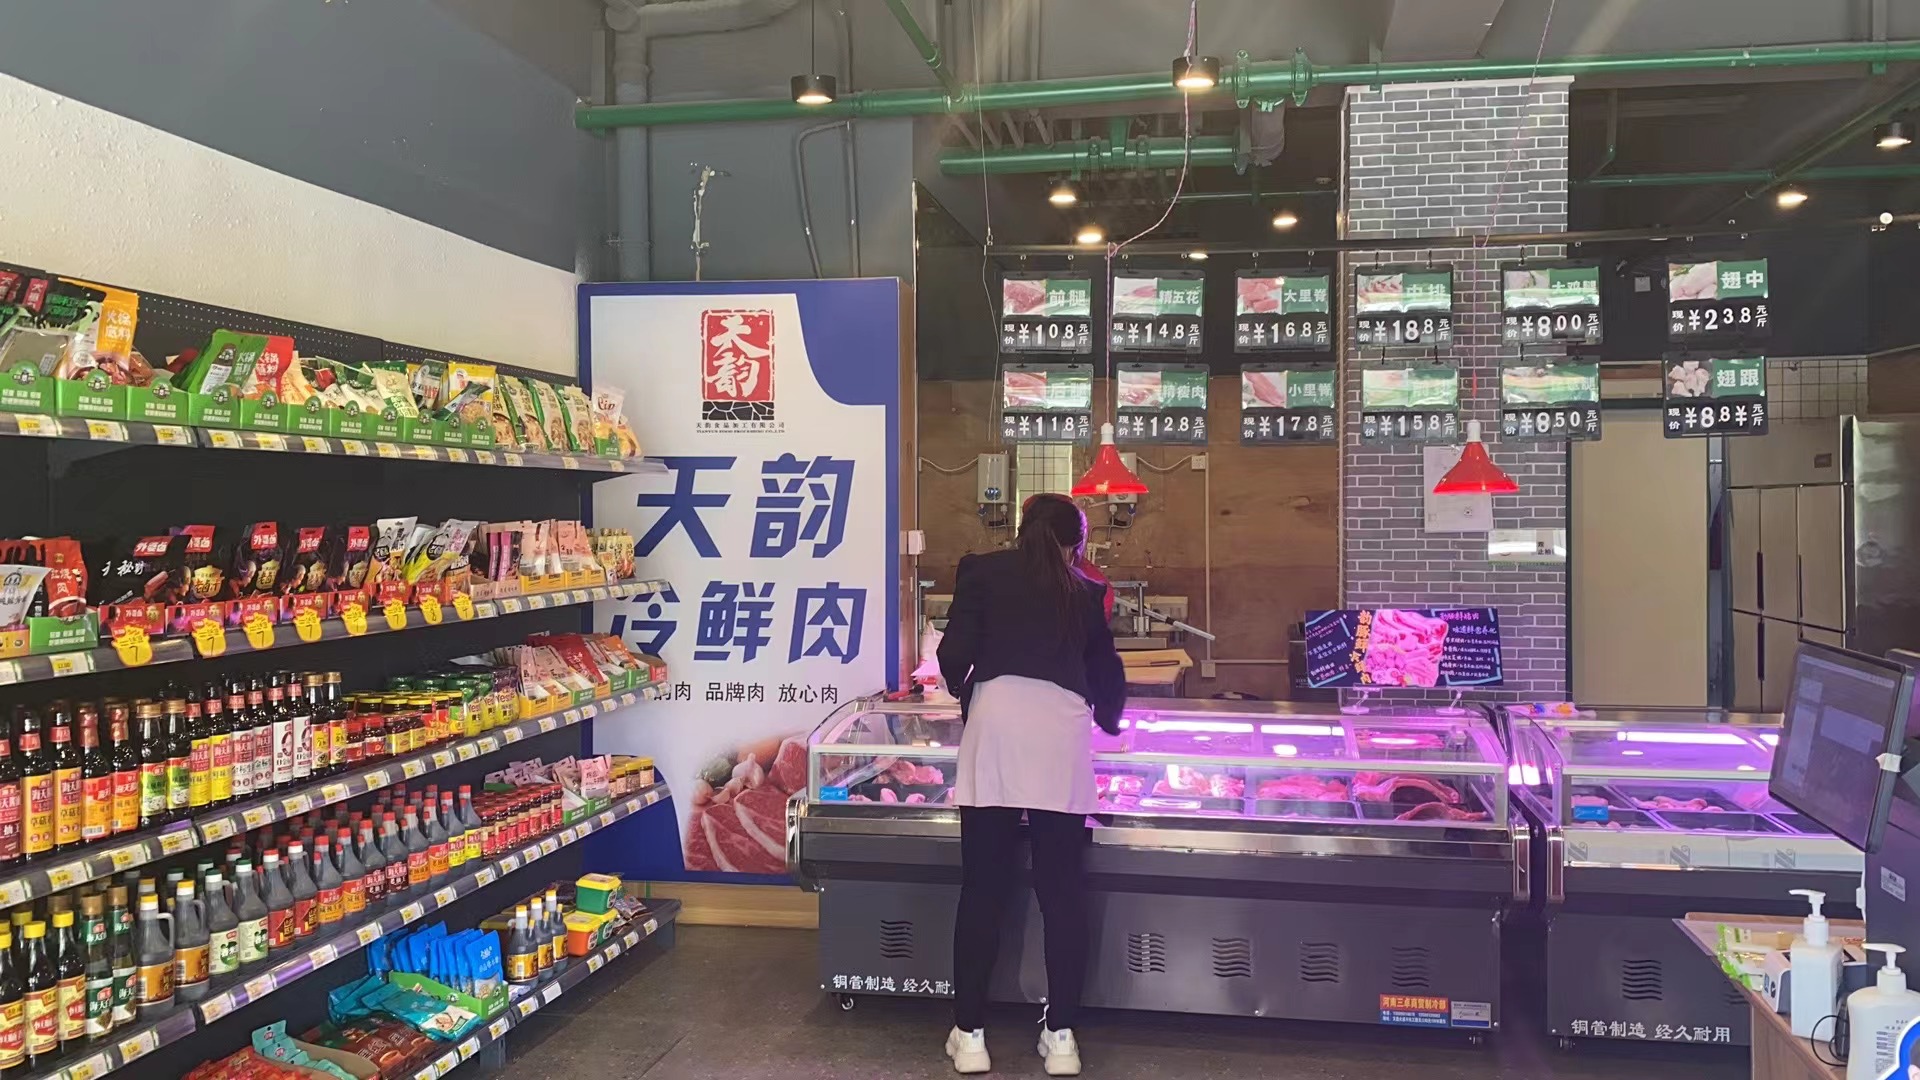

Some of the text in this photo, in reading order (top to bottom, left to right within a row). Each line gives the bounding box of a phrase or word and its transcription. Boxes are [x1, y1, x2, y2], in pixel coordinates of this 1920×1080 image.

[1721, 270, 1763, 289] 翅中
[1158, 289, 1200, 305] 精五花
[1284, 289, 1327, 303] 大里脊
[107, 310, 130, 325] 火锅
[106, 326, 130, 340] 底料
[706, 315, 772, 397] 天韵
[1288, 383, 1332, 398] 小里脊
[634, 453, 856, 558] 天韵
[134, 542, 167, 553] 外婆卤
[254, 534, 277, 545] 外婆卤
[608, 581, 867, 664] 冷鲜肉
[706, 682, 764, 702] 品牌肉
[778, 683, 838, 704] 放心肉
[832, 974, 955, 994] 铜管制造 经久耐
[1571, 1019, 1730, 1042] 铜管制造 经久耐用
